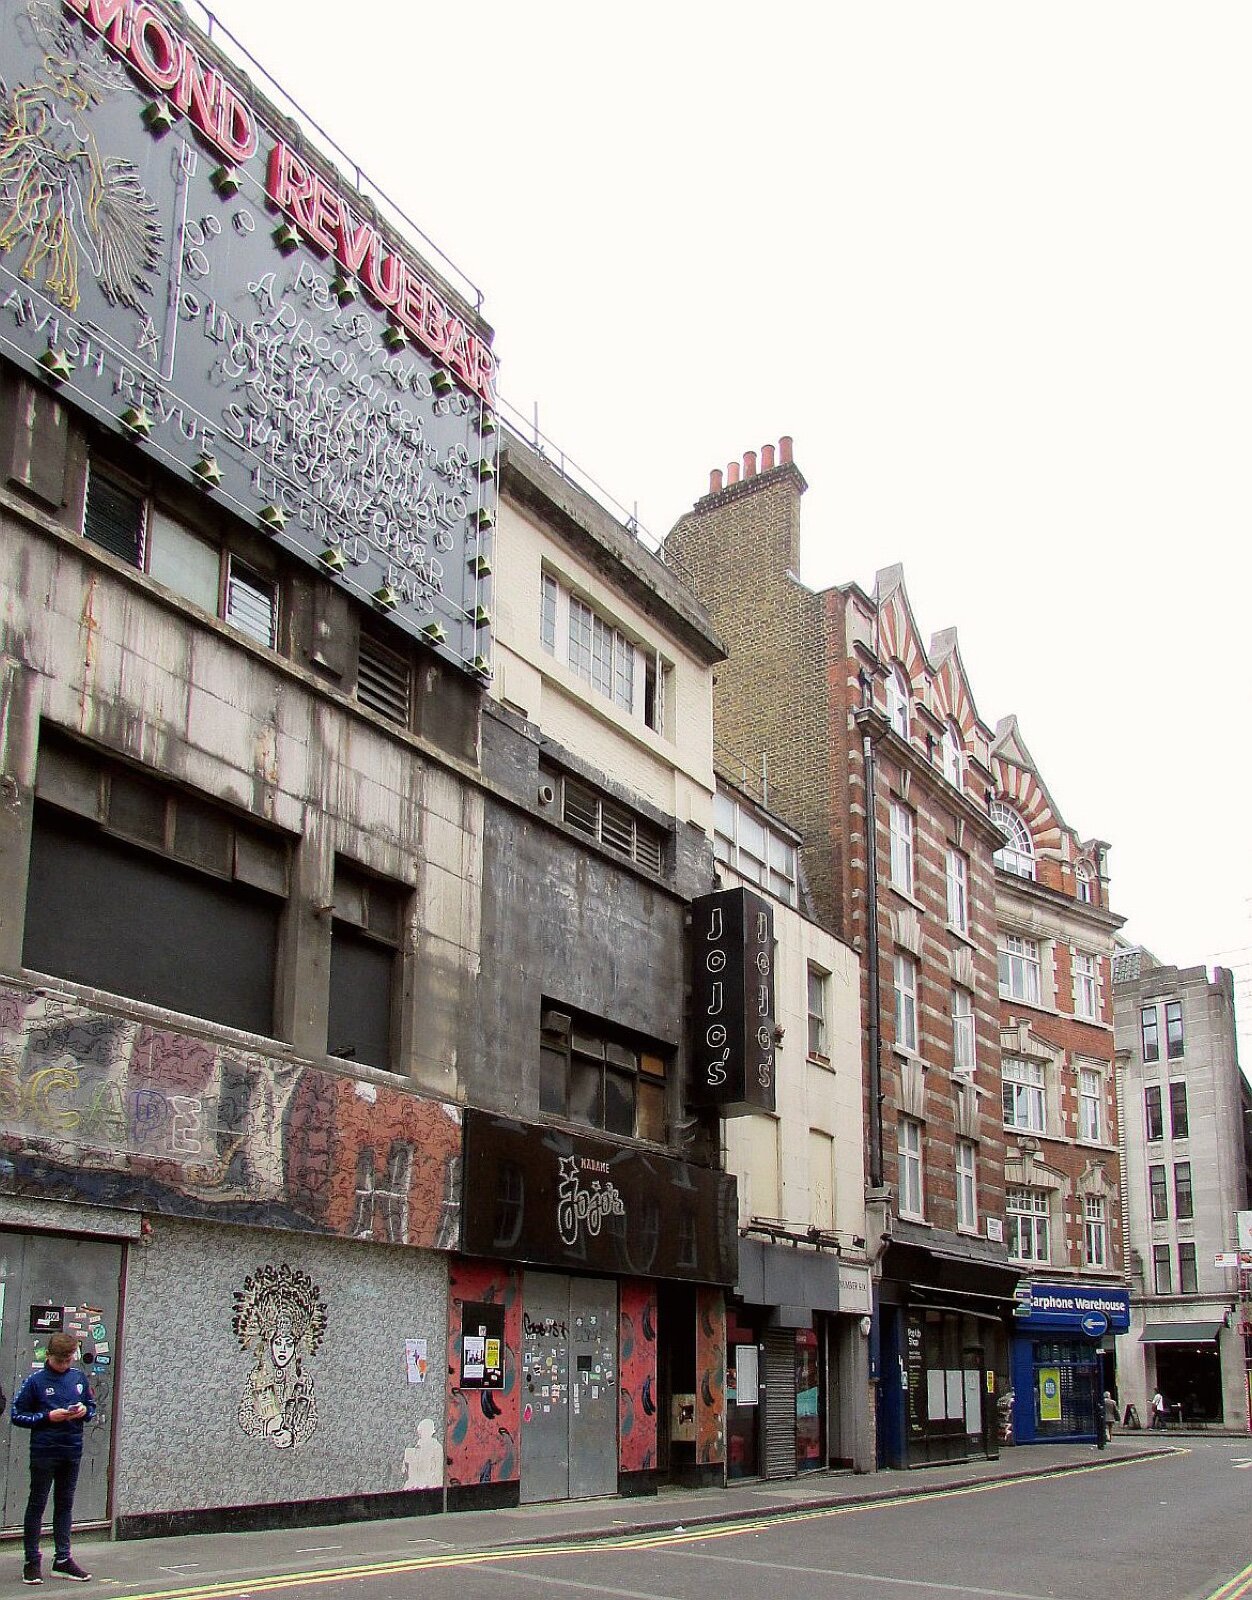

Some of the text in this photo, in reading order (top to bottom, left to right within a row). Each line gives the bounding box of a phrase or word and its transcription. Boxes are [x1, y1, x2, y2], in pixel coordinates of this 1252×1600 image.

[264, 141, 498, 405] REVUEBAR
[580, 1157, 610, 1174] MADAME
[1031, 1295, 1126, 1312] arphone Warehouse
